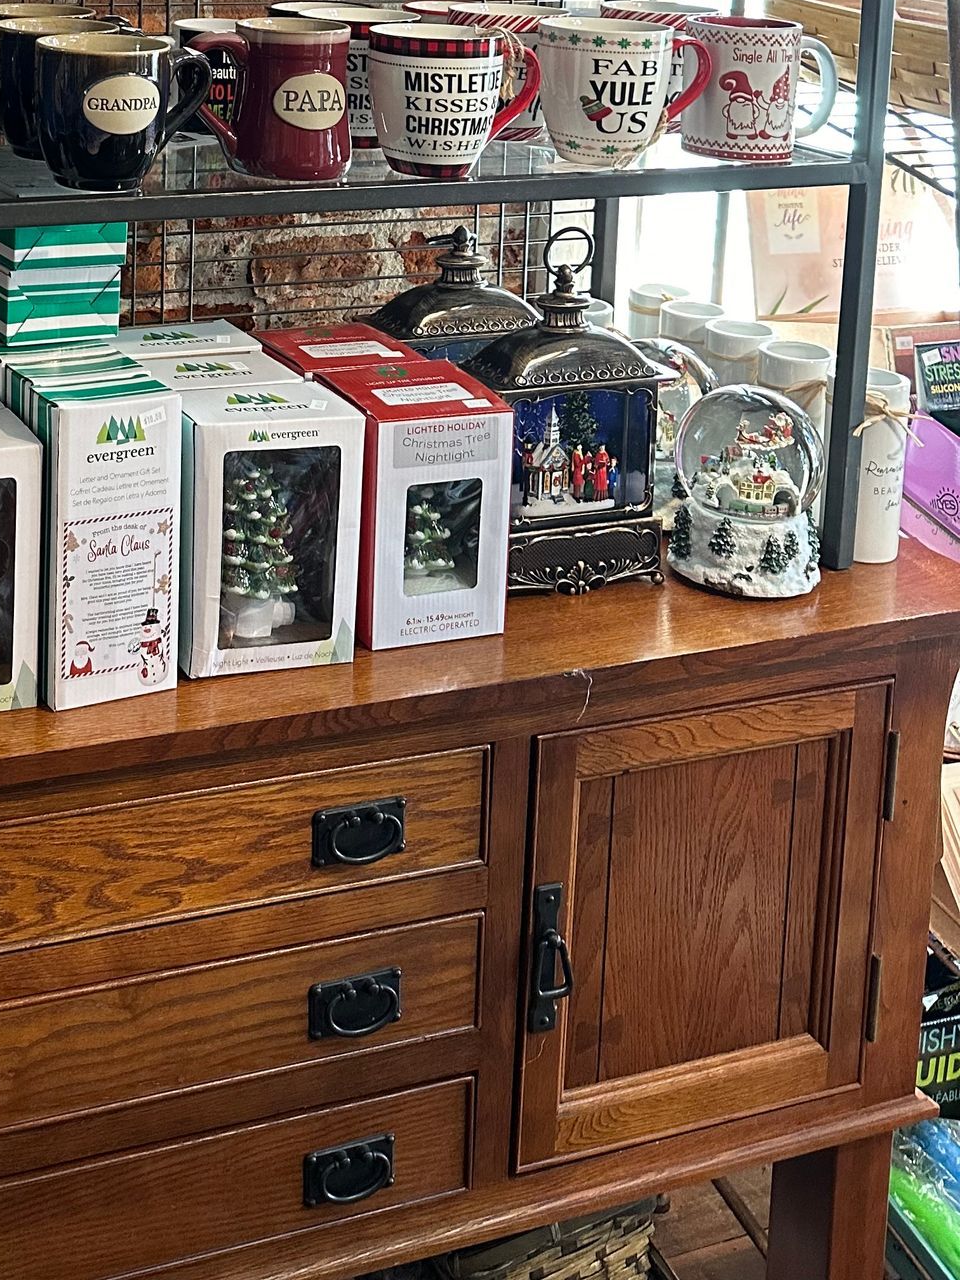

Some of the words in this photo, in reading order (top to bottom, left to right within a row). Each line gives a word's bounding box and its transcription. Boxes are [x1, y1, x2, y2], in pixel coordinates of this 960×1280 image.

[733, 47, 762, 65] Single
[766, 47, 778, 63] All
[592, 58, 657, 77] FAB
[282, 89, 343, 113] PAPA
[589, 80, 656, 107] YULE
[87, 96, 158, 112] GRANDPA
[405, 95, 489, 113] KISSES
[595, 111, 648, 134] US
[774, 209, 811, 231] life
[140, 337, 214, 347] evergreen
[173, 370, 253, 380] evergreen
[224, 403, 309, 413] evergreen
[271, 430, 318, 443] evergreen
[407, 425, 444, 435] LIGHTED
[447, 421, 486, 431] HOLIDAY
[402, 437, 463, 449] Christmas
[465, 431, 491, 445] Tree
[86, 446, 154, 464] evergreen
[415, 450, 475, 463] Nightlight
[92, 528, 111, 538] From
[111, 523, 123, 532] the
[87, 538, 118, 562] Santa
[120, 534, 151, 557] Claus
[400, 624, 437, 636] ELECTRIC
[438, 619, 480, 632] OPERATED
